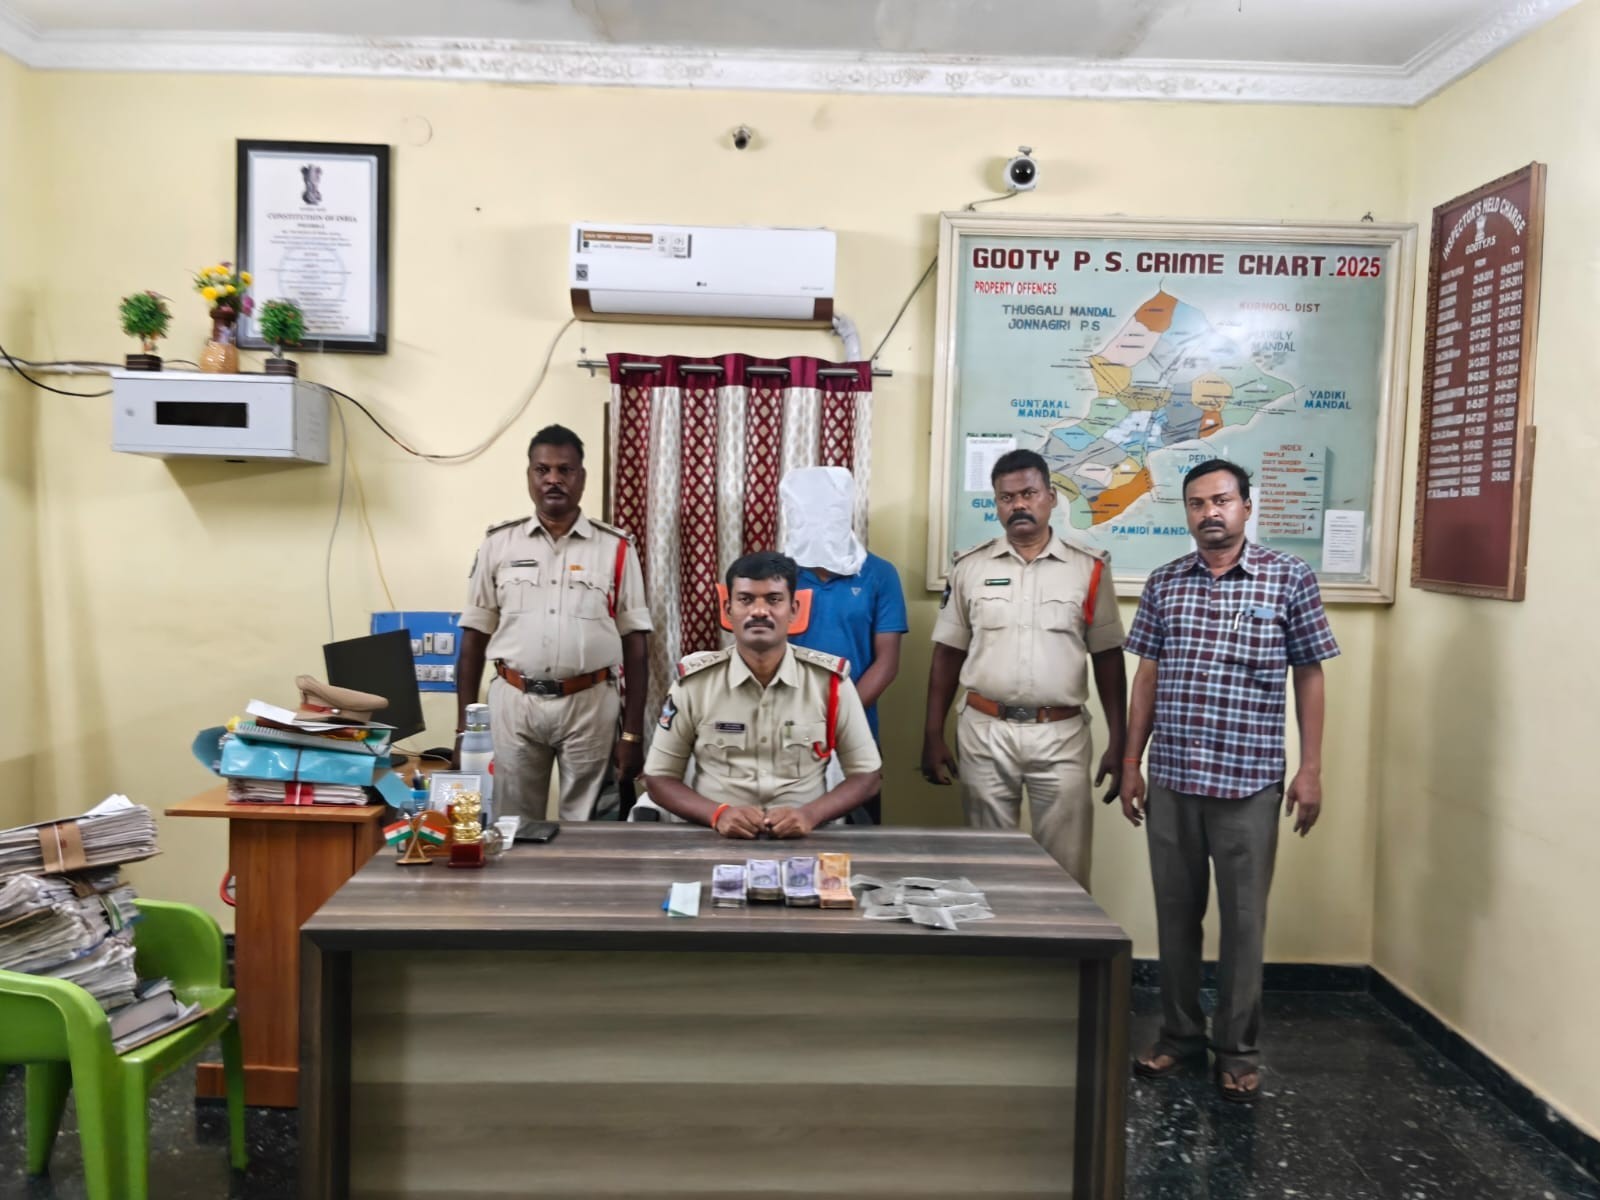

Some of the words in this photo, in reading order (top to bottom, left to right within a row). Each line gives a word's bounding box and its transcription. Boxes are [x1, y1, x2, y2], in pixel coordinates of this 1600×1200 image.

[1442, 201, 1481, 260] INSPECTOR'S
[1500, 198, 1526, 235] CHARGE
[1511, 246, 1520, 255] TO
[973, 247, 1060, 270] GOOTY
[1136, 252, 1224, 274] CRIME
[974, 281, 1014, 295] PROPERTY
[1016, 282, 1057, 295] OFFENCES
[1002, 304, 1064, 316] THUGGALI
[1070, 306, 1116, 318] MANDAL
[1295, 302, 1320, 313] DIST
[1008, 318, 1071, 330] JONNAGIRI
[1309, 391, 1346, 400] YADIKI
[1010, 398, 1070, 409] GUNTAKAL
[1304, 400, 1352, 410] MANDAL
[1017, 409, 1063, 418] MANDAL
[1112, 526, 1149, 535] PAMIDI
[1152, 526, 1188, 535] MAND
